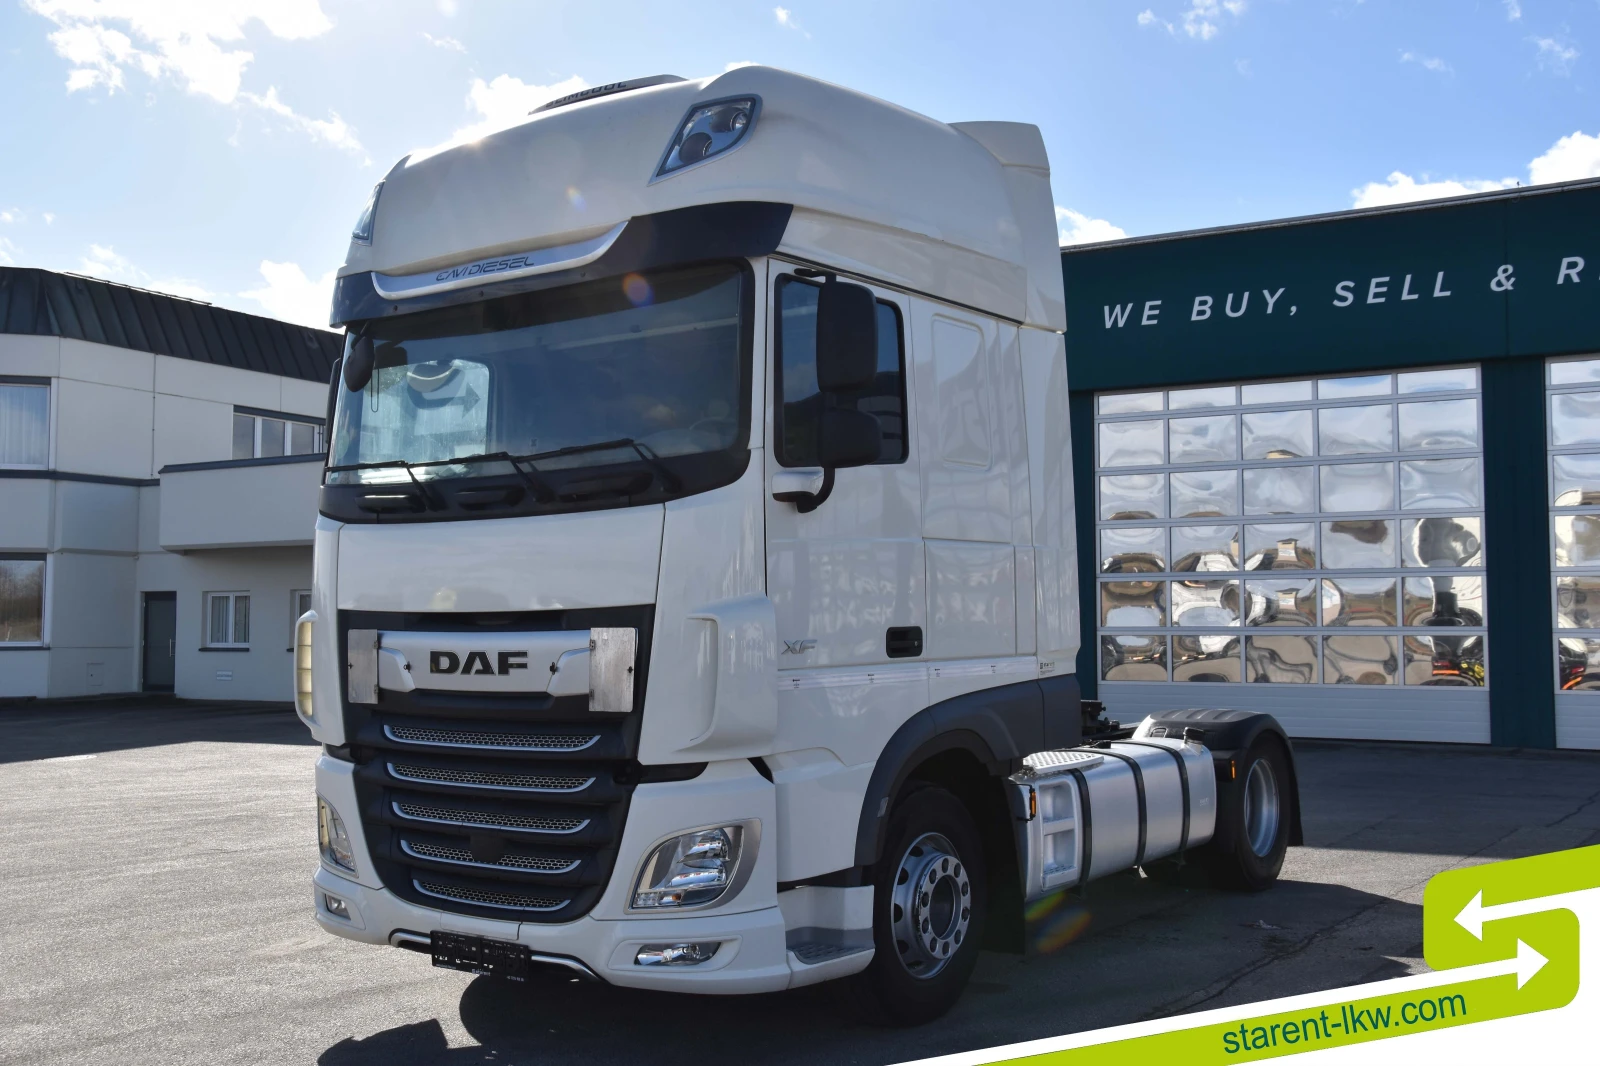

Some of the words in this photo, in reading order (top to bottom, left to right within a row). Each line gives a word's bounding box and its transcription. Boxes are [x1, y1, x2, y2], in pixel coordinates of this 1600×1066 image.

[1103, 299, 1162, 329] WE
[1190, 287, 1297, 322] BUY,
[1332, 271, 1452, 308] SELL
[1489, 264, 1516, 292] &
[1556, 256, 1600, 286] R
[781, 639, 818, 655] XF
[429, 650, 528, 676] DAF
